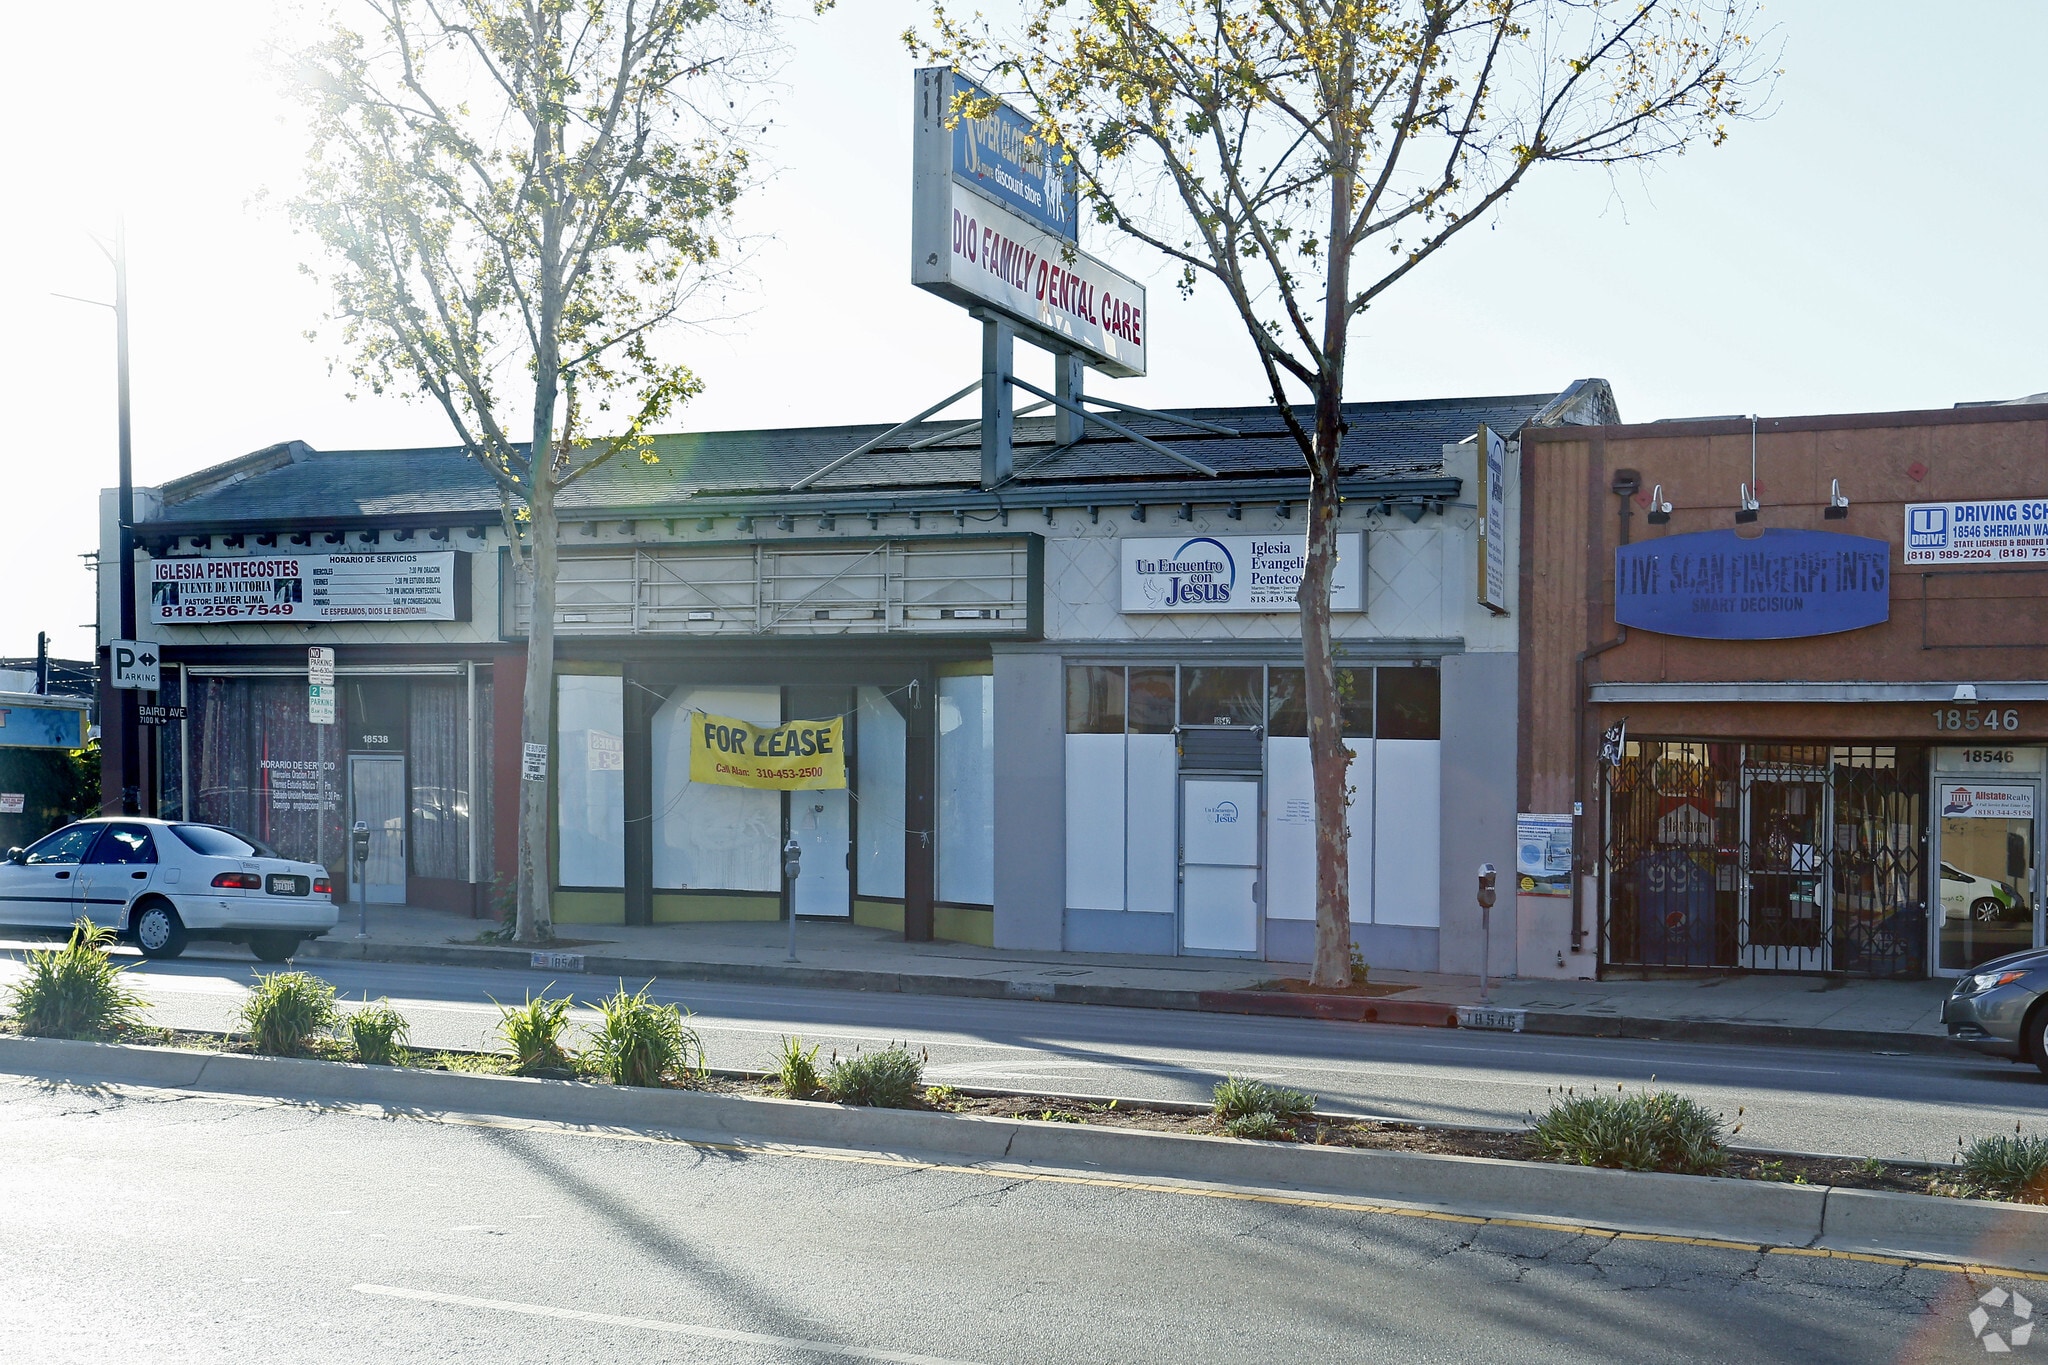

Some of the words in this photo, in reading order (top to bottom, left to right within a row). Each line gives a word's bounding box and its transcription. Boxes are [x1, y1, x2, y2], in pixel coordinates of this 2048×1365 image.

[995, 164, 1024, 198] discount
[1024, 184, 1042, 207] store
[953, 207, 978, 264] DIO
[982, 226, 1036, 293] FAMILY
[1036, 258, 1098, 326] DENTAL
[1102, 292, 1141, 346] CARE
[1954, 504, 2017, 522] DRIVING
[1953, 525, 1981, 538] 18546
[1984, 524, 2031, 538] SHERMAN
[1911, 534, 1946, 545] DRIVE
[1954, 540, 1974, 548] STATE
[1976, 540, 2008, 548] LICENSED
[2016, 538, 2044, 546] BONDED
[1252, 541, 1291, 556] Iglesia
[1907, 550, 1935, 561] (818)
[1938, 549, 1992, 560] 989-2204
[1999, 548, 2028, 560] (818)
[2032, 548, 2048, 558] 75
[156, 563, 204, 580] IGLESIA
[208, 560, 299, 578] PENTECOSTES
[1136, 560, 1156, 574] Un
[1158, 558, 1224, 574] Encuentro
[1252, 556, 1304, 572] Evangeli
[1190, 572, 1213, 584] con
[1252, 572, 1303, 584] Pentecos
[1670, 553, 1724, 594] SCAN
[180, 582, 212, 594] FUENTE
[216, 581, 227, 593] DE
[230, 580, 272, 592] VICTORIA
[1166, 576, 1232, 606] Jesus
[214, 596, 242, 605] ELMER
[244, 595, 264, 604] LIMA
[1692, 598, 1736, 613] SMART
[1740, 596, 1804, 612] DECISION
[162, 604, 294, 618] 818.256-7549
[330, 608, 367, 616] ESPERAMOS,
[310, 648, 320, 658] NO
[311, 659, 332, 667] PARKING
[311, 698, 333, 706] PARKING
[139, 706, 166, 716] BAIRD
[1932, 709, 2019, 731] 18546
[362, 734, 389, 744] 18538
[704, 722, 748, 755] FOR
[754, 728, 833, 757] LEASE
[1962, 750, 2014, 763] 18546
[260, 760, 292, 769] HORARIO
[304, 761, 335, 770] SERVCIO
[716, 763, 731, 774] Call
[732, 766, 750, 777] Alan:
[756, 766, 823, 779] 310-453-2500
[1215, 814, 1237, 823] Jesus
